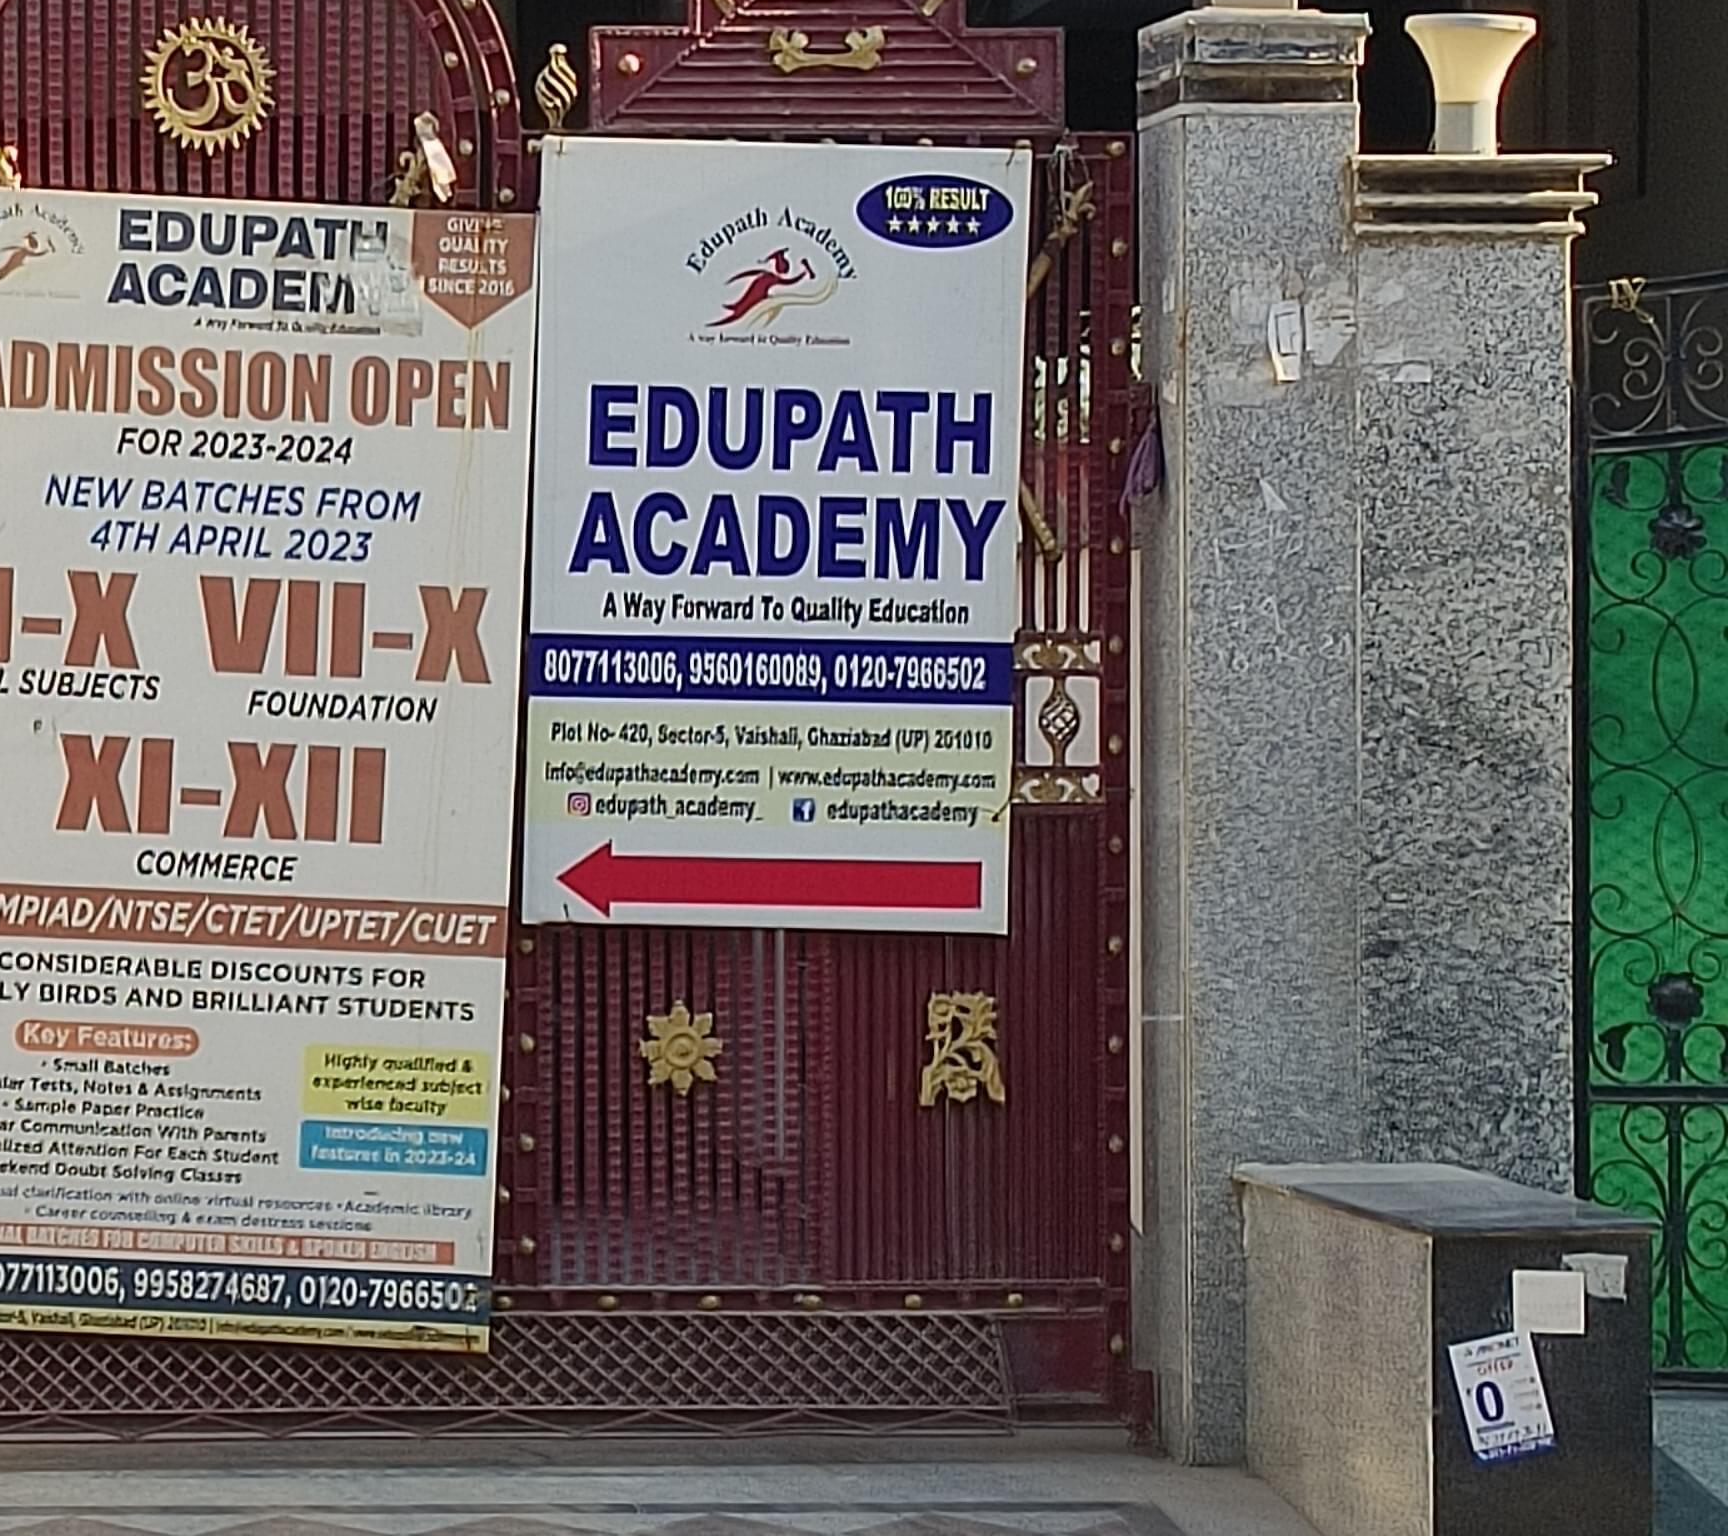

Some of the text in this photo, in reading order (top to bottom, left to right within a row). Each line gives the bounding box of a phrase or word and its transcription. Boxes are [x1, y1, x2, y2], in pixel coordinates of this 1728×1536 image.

[885, 186, 991, 211] 100% RESULT
[118, 208, 388, 261] EDUPATH
[685, 206, 858, 281] Edupath Academy
[438, 258, 507, 275] RESULTS
[428, 277, 514, 297] SINCE 2016
[350, 355, 511, 430] OPEN
[588, 384, 993, 475] EDUPATH
[117, 427, 354, 465] FOR 2023-2024
[45, 473, 422, 522] NEW BATCHES FROM
[90, 519, 372, 562] 4TH APRIL 2023
[568, 492, 1007, 582] ACADEMY
[602, 591, 969, 629] A Way Forward To Quality Education
[199, 574, 492, 685] VII-X
[18, 669, 162, 701] SUBJECTS
[544, 648, 987, 695] 8077113006, 9560160089, 0120-7966502
[246, 690, 439, 723] FOUNDATION
[551, 722, 582, 742] Plot
[619, 723, 653, 748] 420,
[658, 724, 729, 748] Sector-5,
[808, 727, 891, 748] Ghaziabad
[895, 729, 929, 754] (UP)
[934, 730, 992, 750] 201010
[55, 732, 387, 845] XI-XII
[135, 850, 299, 882] COMMERCE
[211, 960, 363, 987] DISCOUNTS
[372, 968, 426, 989] FOR
[39, 982, 117, 1005] BIRDS
[125, 988, 182, 1008] AND
[192, 990, 329, 1015] BRILLIANT
[338, 997, 476, 1021] STUDENTS
[24, 1022, 69, 1048] Key
[53, 1058, 170, 1076] Small Batches
[324, 1053, 457, 1074] Highly qualified
[31, 1077, 79, 1095] Tests,
[84, 1080, 132, 1095] Notes
[154, 1083, 262, 1102] Assignments
[312, 1075, 483, 1095] experienced subject
[15, 1098, 204, 1120] Sample Paper Practice
[345, 1098, 447, 1116] wise faculty
[21, 1119, 152, 1138] Communication
[157, 1126, 198, 1141] With
[203, 1128, 266, 1144] Parents
[50, 1142, 128, 1158] Attention
[134, 1146, 163, 1160] For
[168, 1146, 207, 1162] Each
[212, 1149, 279, 1165] Student
[54, 1161, 106, 1178] Doubt
[112, 1165, 174, 1184] Solving
[180, 1167, 242, 1184] Classes
[134, 1267, 292, 1309] 9958274687,
